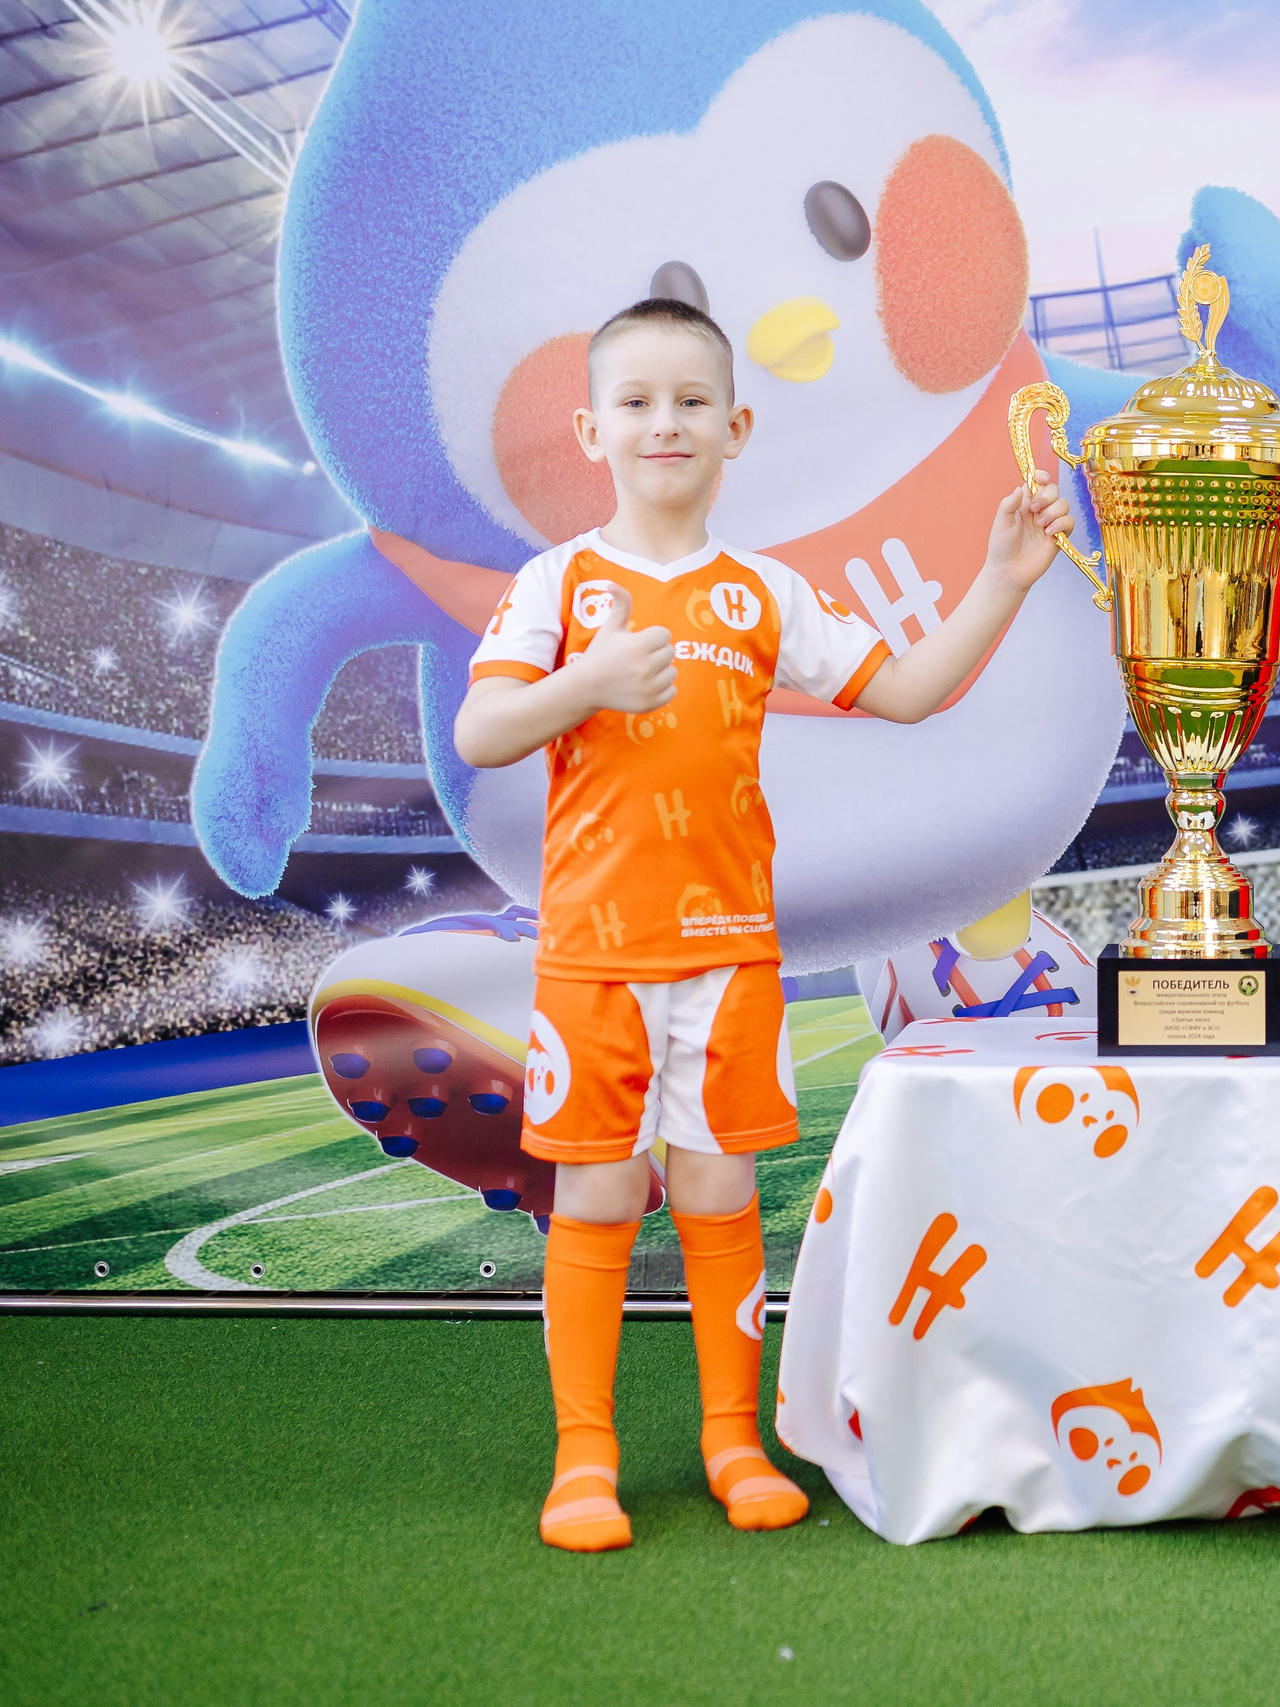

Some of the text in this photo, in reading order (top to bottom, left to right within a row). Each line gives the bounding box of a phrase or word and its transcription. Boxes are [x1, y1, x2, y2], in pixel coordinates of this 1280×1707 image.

[673, 640, 755, 678] ЕЖДИК
[681, 926, 727, 938] ВМЕСТЕ
[1152, 979, 1230, 991] ПОБЕДИТЕЛЬ
